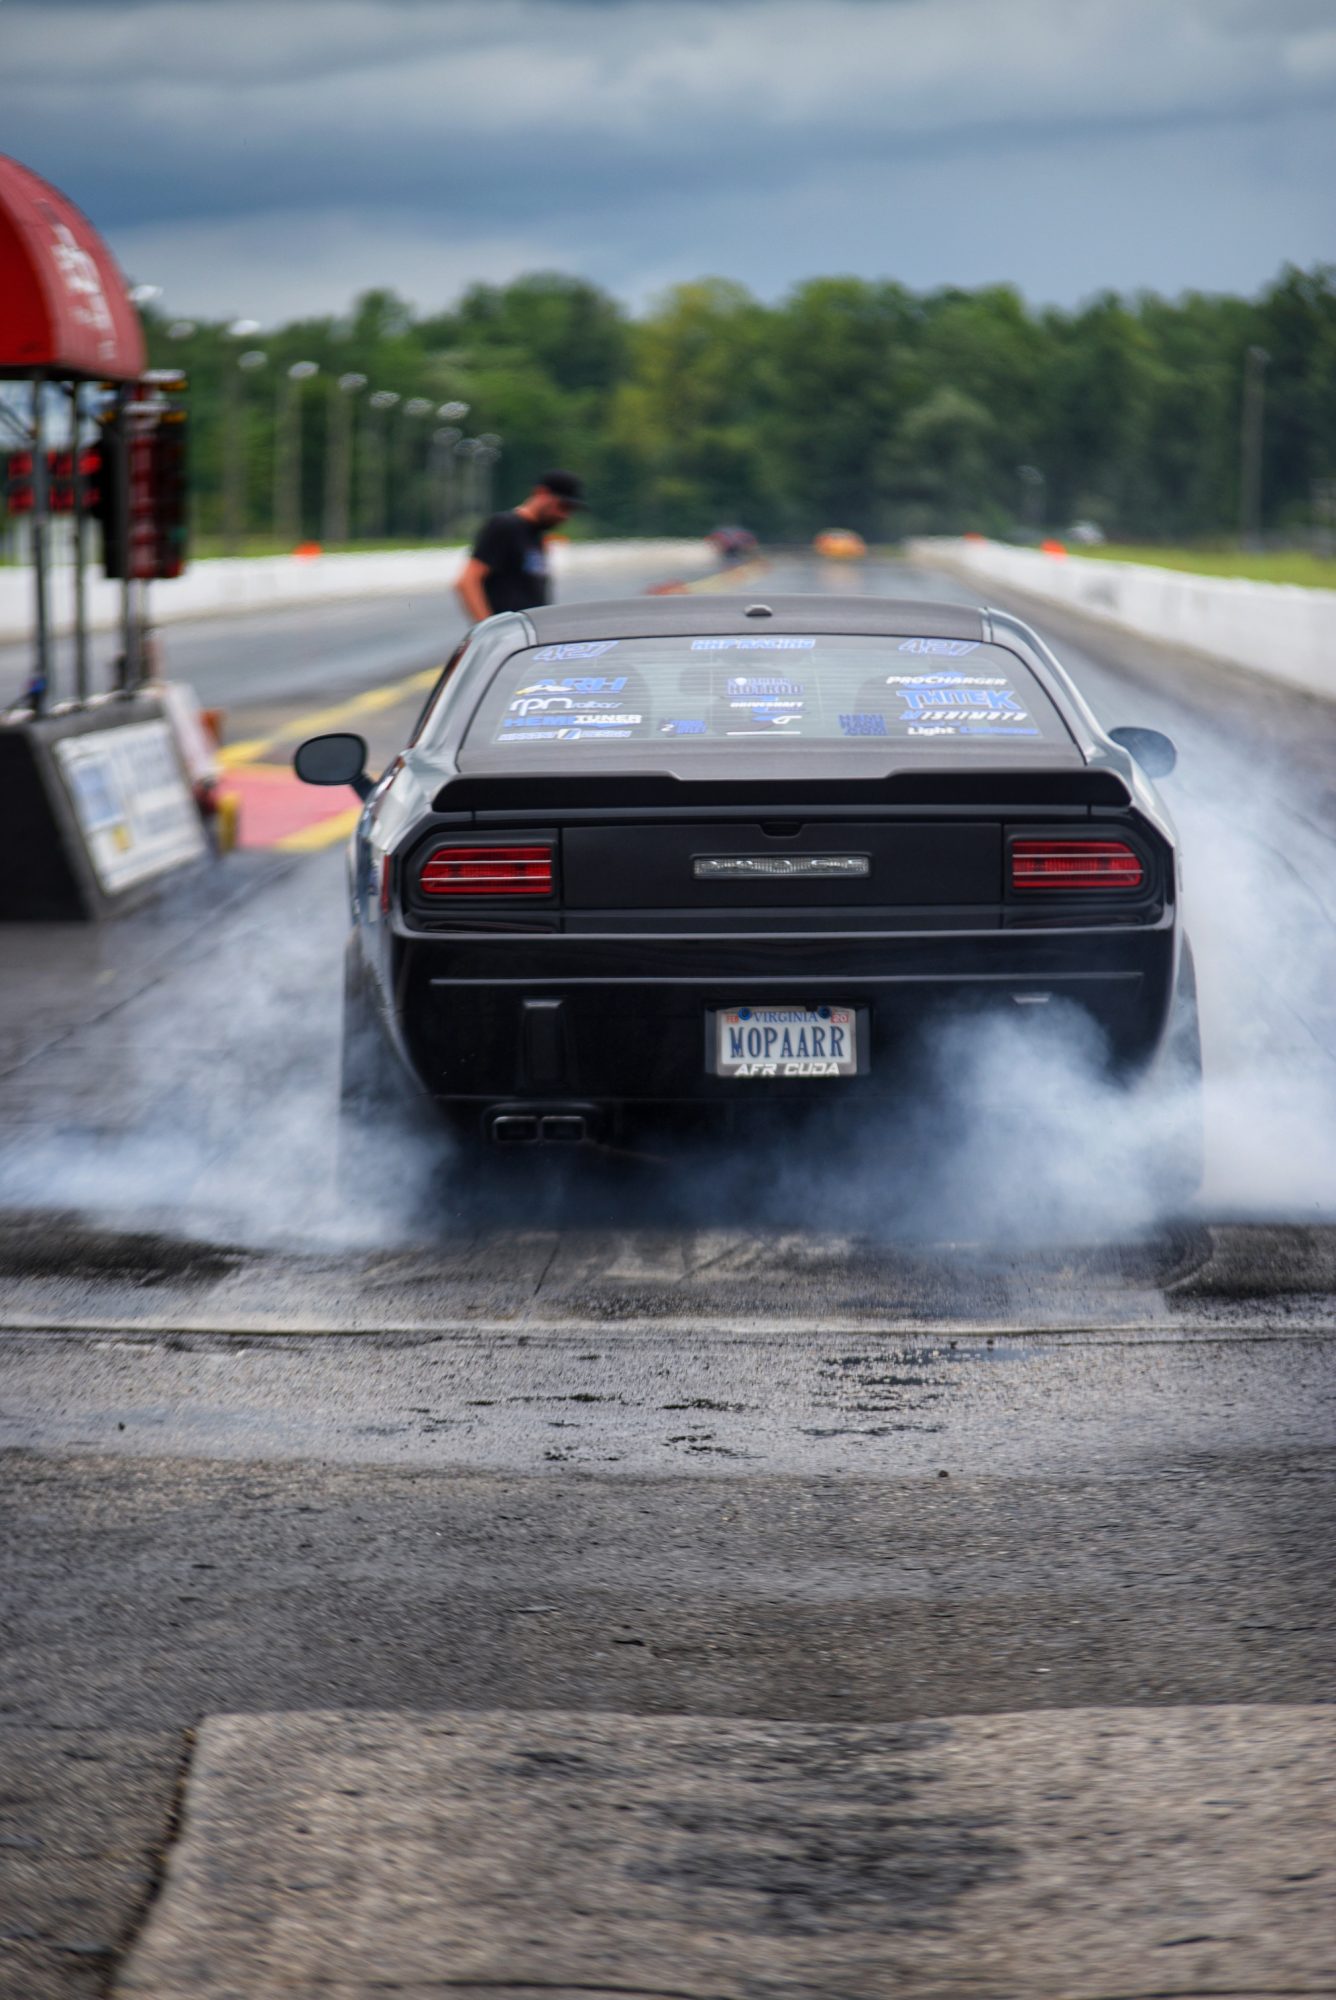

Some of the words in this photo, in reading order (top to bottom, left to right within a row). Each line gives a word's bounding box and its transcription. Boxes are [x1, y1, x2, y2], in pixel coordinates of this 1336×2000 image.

[532, 640, 619, 661] 427
[899, 638, 982, 656] 427
[907, 727, 956, 736] Light
[754, 1012, 818, 1023] VIRGINIA
[832, 1015, 848, 1023] 20
[729, 1026, 845, 1059] MOPAARR
[734, 1063, 777, 1077] AFR
[784, 1063, 841, 1076] CUDA
